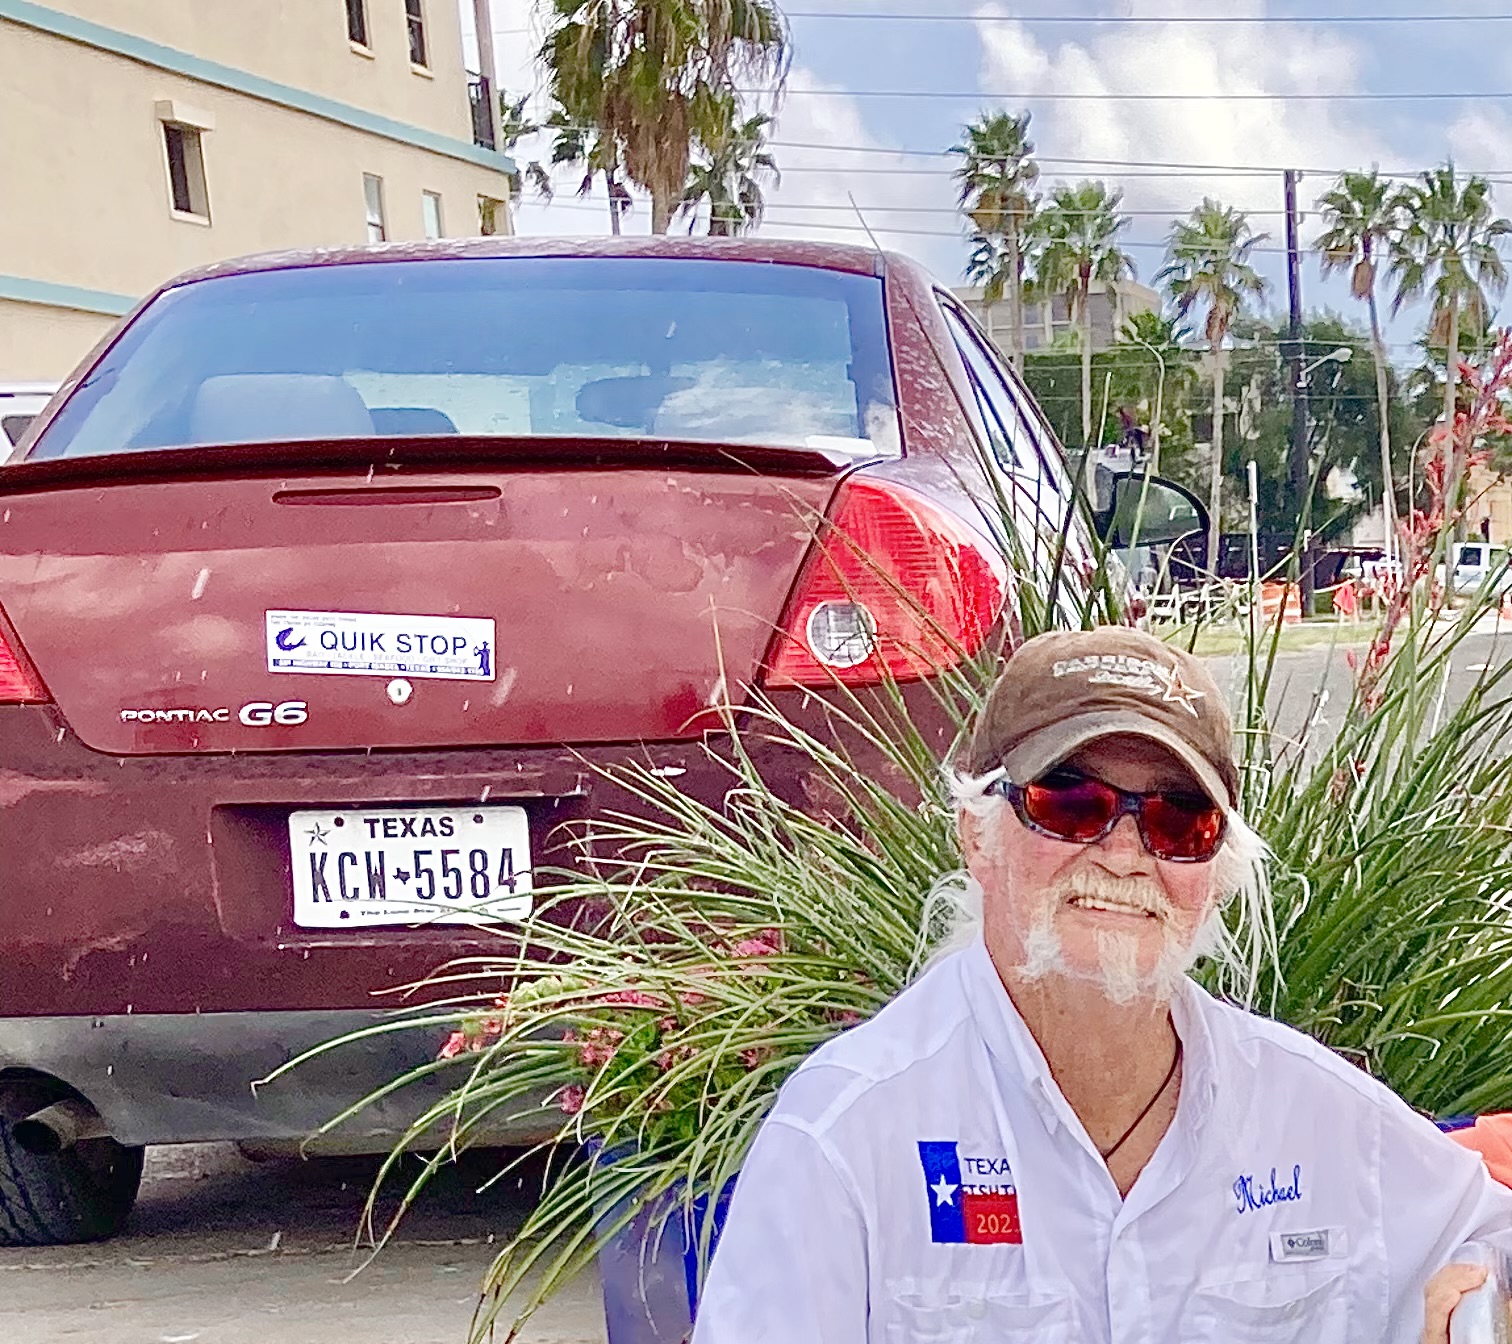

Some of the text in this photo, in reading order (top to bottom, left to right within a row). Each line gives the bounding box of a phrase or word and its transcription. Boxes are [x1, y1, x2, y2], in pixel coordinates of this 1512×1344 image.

[320, 630, 467, 655] QUIK STOP
[120, 701, 308, 726] PONTIAC G6
[363, 816, 455, 838] TEXAS
[1232, 1164, 1302, 1214] Michael
[976, 1214, 1021, 1234] 202
